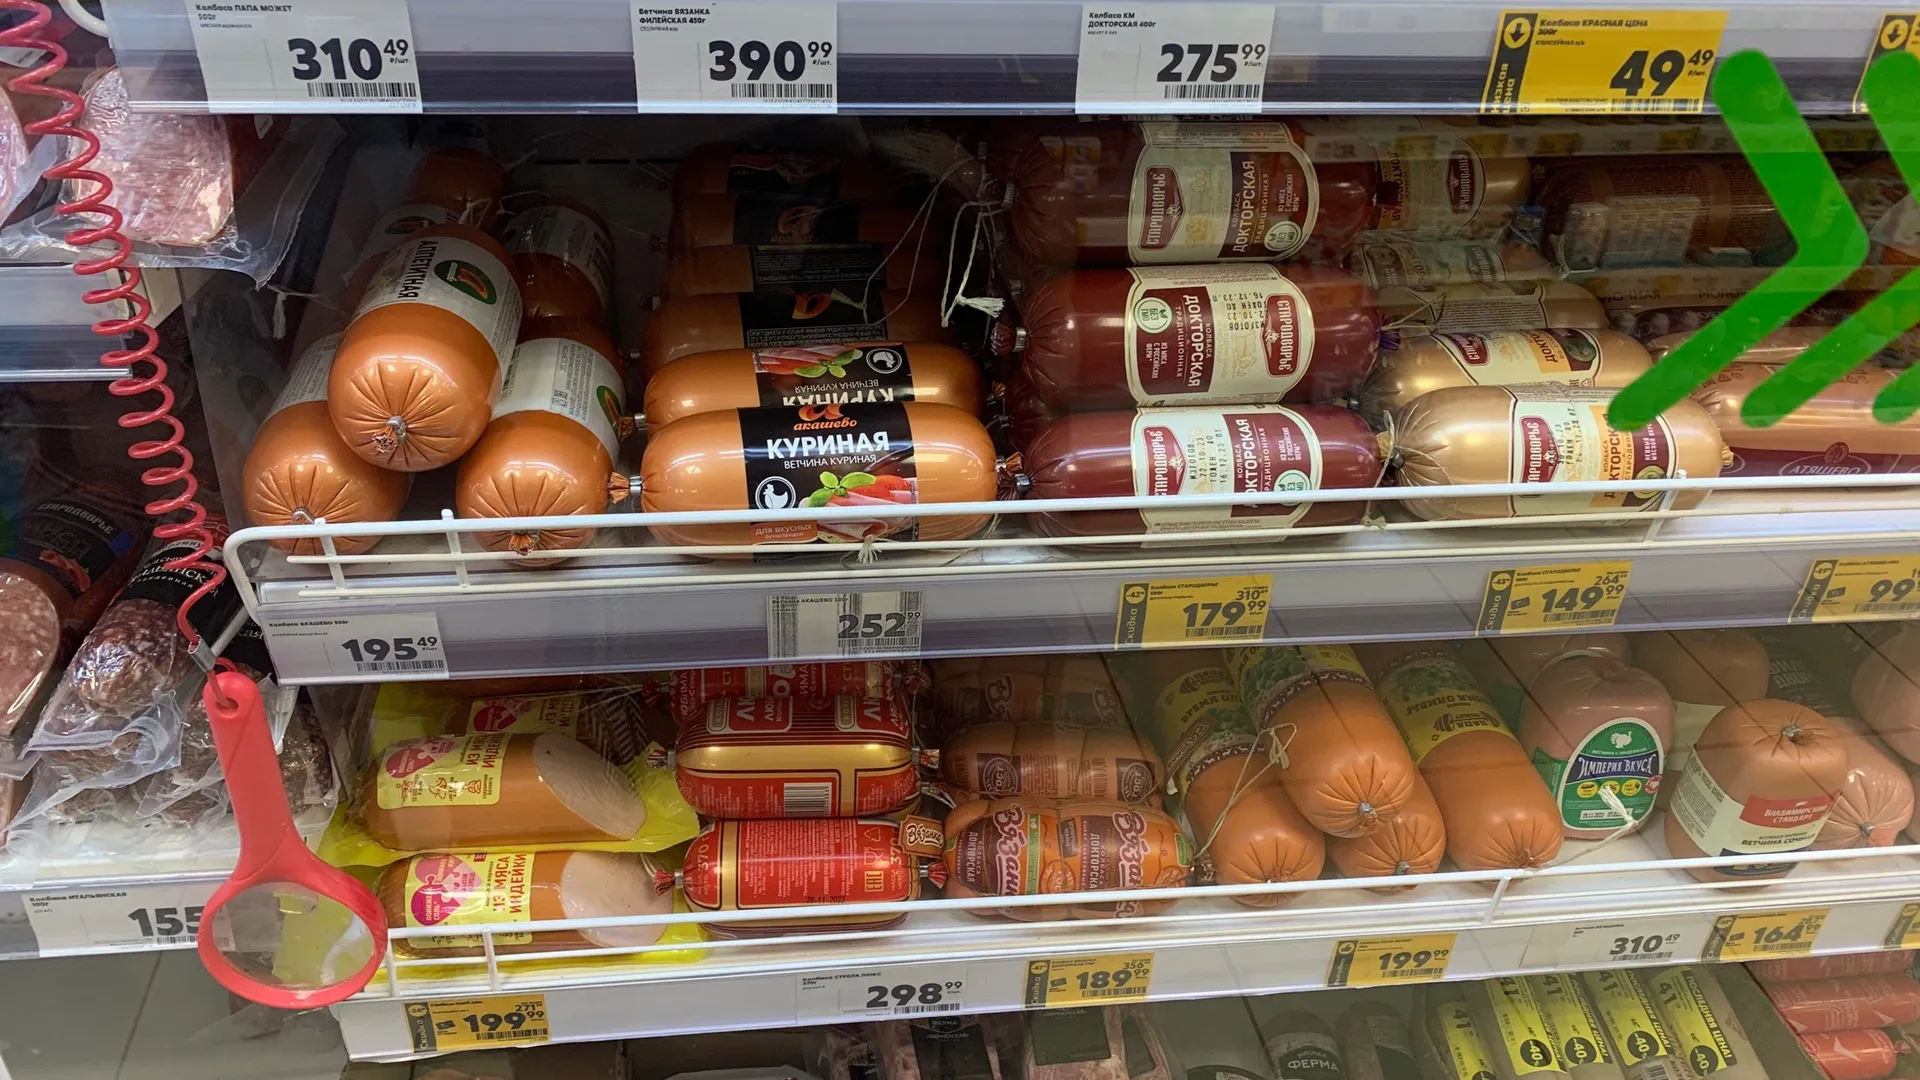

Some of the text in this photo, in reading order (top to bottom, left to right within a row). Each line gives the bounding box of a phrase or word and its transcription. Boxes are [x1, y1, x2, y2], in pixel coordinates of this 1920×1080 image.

[196, 4, 292, 15] Колбаса ПАПА МОЖЕТ
[639, 8, 710, 19] Ветчина ВЯЗАНКА
[1089, 12, 1122, 20] Колбаса
[688, 17, 706, 25] 450г
[1540, 19, 1648, 29] Колбаса КРАСНАЯ ЦЕНА
[383, 38, 409, 56] 49
[808, 41, 832, 58] 99
[1242, 44, 1266, 60] 99
[1688, 49, 1714, 66] 49
[287, 38, 383, 81] 310
[709, 40, 806, 81] 390
[1156, 43, 1239, 82] 275
[1609, 50, 1686, 97] 49
[1146, 173, 1166, 245] СТАРОДВОРЬЕ
[1231, 192, 1241, 228] КОЛБАСА
[1232, 160, 1254, 253] ДОКТОРСКАЯ
[1253, 173, 1269, 244] ТРАДИЦИОННАЯ
[397, 240, 438, 300] АППЕТИТНАЯ
[1140, 308, 1150, 321] ГМО
[1149, 308, 1159, 320] БЕЗ
[1174, 305, 1183, 377] ТРАДИЦИОННАЯ
[1183, 294, 1203, 387] ДОКТОРСКАЯ
[1278, 301, 1294, 370] СТАРОДВОРЬЕ
[1160, 349, 1168, 364] МЯСА
[795, 379, 879, 393] ВЕТЧИНА КУРИНАЯ
[793, 416, 858, 432] акашево
[767, 431, 890, 460] КУРИНАЯ
[1527, 421, 1540, 483] ТАРОДВОРЬЕ
[784, 454, 878, 469] ВЕТЧИНА КУРИНАЯ
[1259, 427, 1270, 493] РАДИЦИОННАЯ
[755, 523, 812, 537] ДЛЯ ВКУСНЫХ
[1594, 575, 1619, 586] 264
[1606, 585, 1625, 595] 99
[1868, 579, 1915, 603] 99
[1236, 591, 1260, 601] 310
[1247, 600, 1267, 611] 99
[1542, 586, 1604, 613] 149
[907, 612, 921, 620] 99
[1183, 601, 1245, 628] 179
[1485, 595, 1502, 632] Скидка
[838, 612, 906, 638] 252
[1125, 608, 1138, 645] Скидка
[342, 638, 417, 661] 195
[417, 636, 437, 647] 49
[465, 754, 479, 765] ИЗ
[1577, 754, 1657, 779] ИМПЕРИЯ ВКУСА
[995, 766, 1005, 793] ГОСТ
[1133, 771, 1142, 799] ГОСТ
[1763, 804, 1829, 818] ВЛАДИМИРСКИЙ
[1772, 815, 1813, 825] СТАНДАРТ
[906, 824, 943, 848] Вязанка
[1742, 833, 1816, 847] ВЕТЧИНА СОЧНАЯ
[697, 844, 709, 870] 370
[968, 832, 979, 884] ДОКТОРСКАЯ
[1090, 832, 1099, 892] ДОКТОРСКА
[1098, 844, 1107, 886] КОЛБАСА
[494, 857, 510, 889] МЯСА
[507, 854, 527, 914] ИНДЕЙКИ
[68, 892, 127, 901] ИТАЛЬЯНСКАЯ
[806, 896, 846, 905] 28.11.2023
[128, 905, 206, 938] 155
[1806, 924, 1822, 932] 99
[1665, 933, 1681, 943] 49
[1753, 924, 1802, 945] 164
[1433, 950, 1450, 958] 99
[1609, 935, 1664, 956] 310
[1123, 962, 1144, 970] 356
[1379, 950, 1433, 971] 199
[1076, 970, 1132, 991] 189
[1133, 969, 1149, 977] 99
[1598, 971, 1618, 991] 41
[945, 982, 962, 990] 99
[1031, 977, 1041, 1006] Скидка
[1542, 975, 1562, 995] 41
[1659, 982, 1676, 1005] 41
[866, 983, 942, 1009] 298
[515, 1004, 538, 1013] 271
[527, 1011, 544, 1019] 99
[1452, 1008, 1470, 1030] 41
[1628, 971, 1671, 1048] ПОСЛЕДНЯЯ ЦЕНА!
[1686, 975, 1733, 1059] ПОСЛЕДНЯЯ ЦЕНА!
[464, 1012, 526, 1033] 199
[417, 1020, 428, 1050] Скидка
[1593, 1028, 1608, 1057] ЦЕНА!
